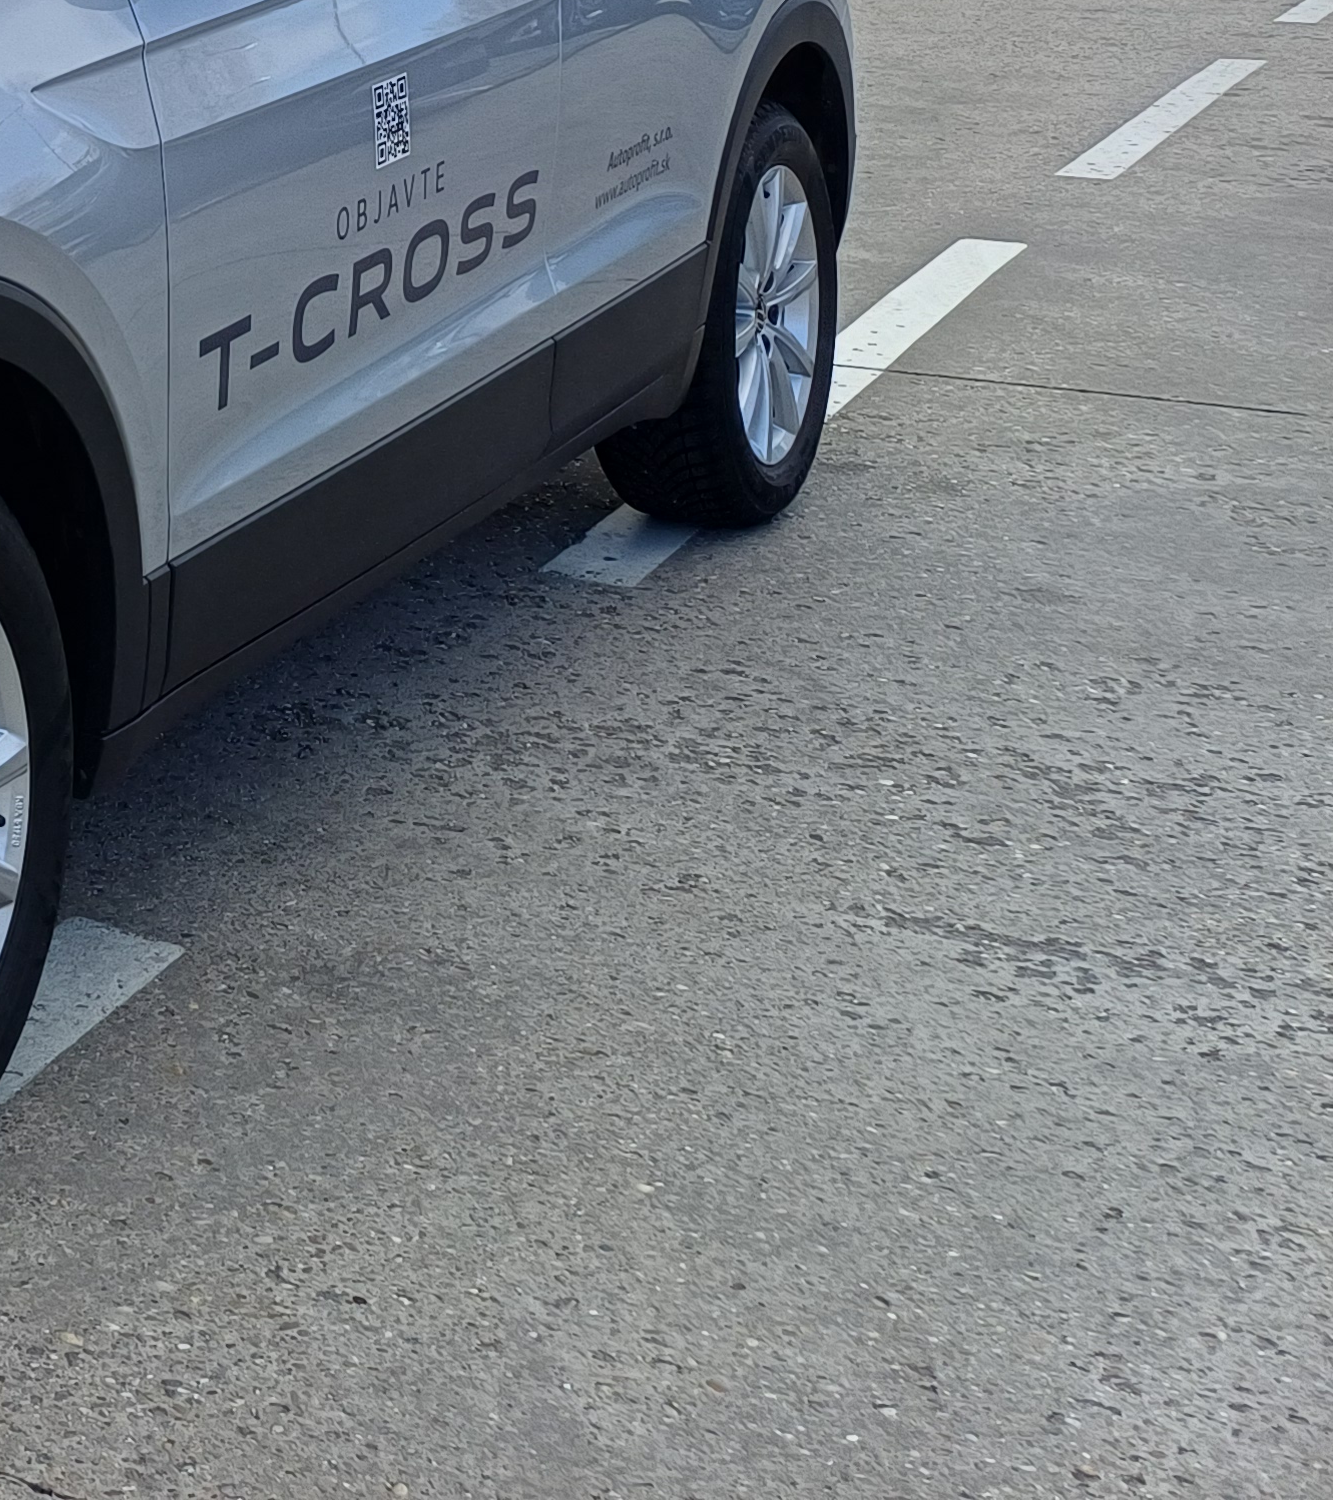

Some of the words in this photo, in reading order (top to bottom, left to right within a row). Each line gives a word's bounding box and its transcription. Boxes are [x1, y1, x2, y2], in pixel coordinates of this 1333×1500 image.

[595, 152, 671, 210] www.autoprofit.sk
[606, 132, 651, 173] Autoprofit,
[335, 160, 447, 241] OBJAVTE
[198, 169, 540, 412] T-CROSS
